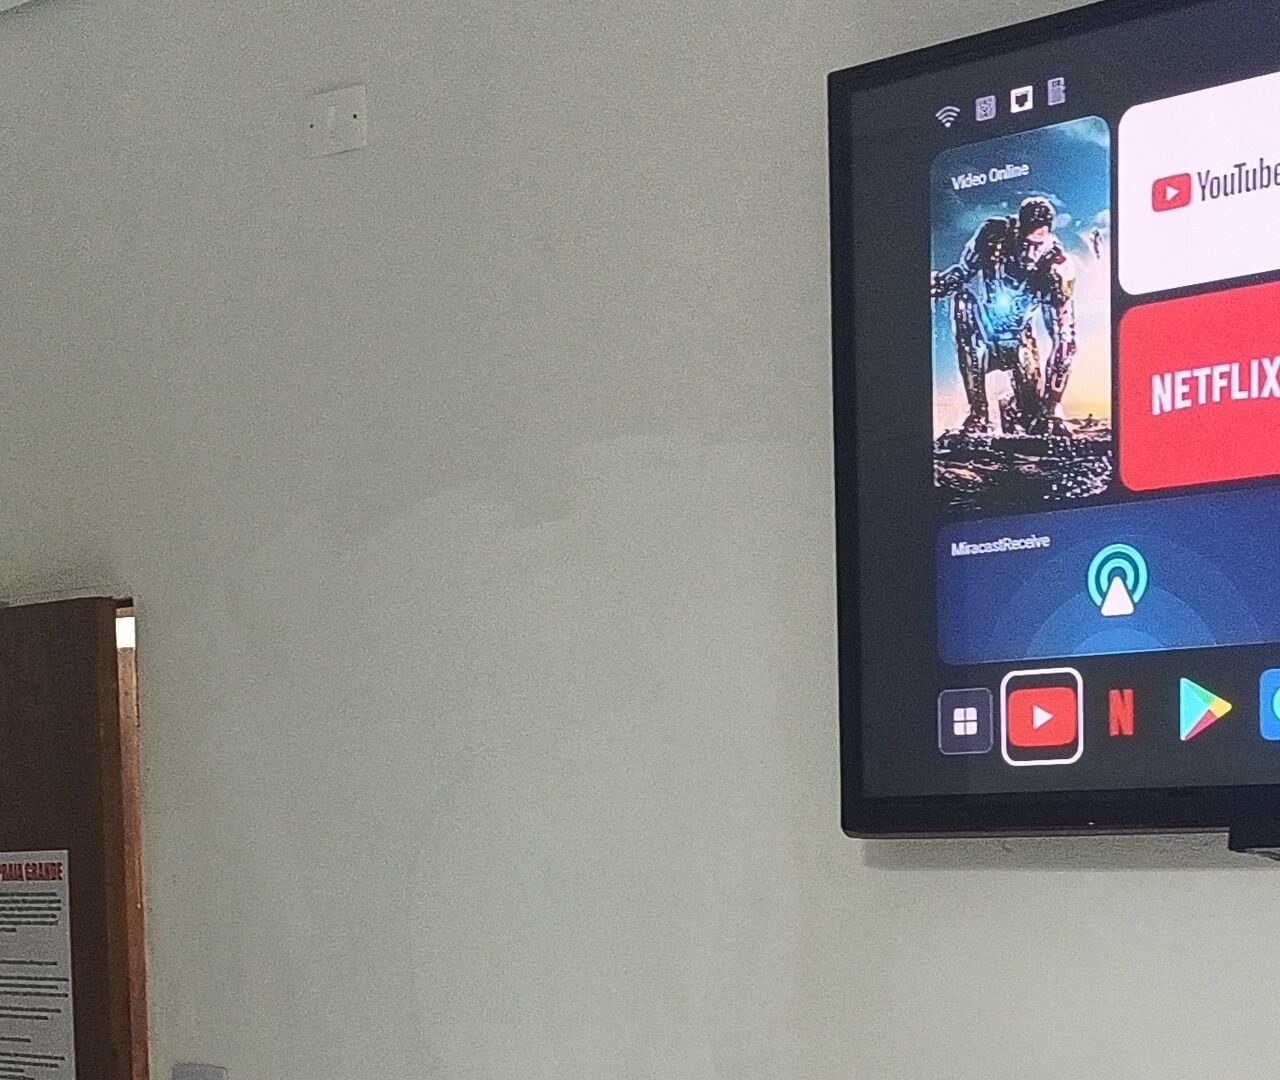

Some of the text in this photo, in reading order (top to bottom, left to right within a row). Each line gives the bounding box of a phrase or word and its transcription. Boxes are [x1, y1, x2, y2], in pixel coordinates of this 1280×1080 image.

[951, 164, 1030, 190] Video Online
[951, 533, 1051, 557] MiracastReceive
[25, 862, 64, 881] GRANDE
